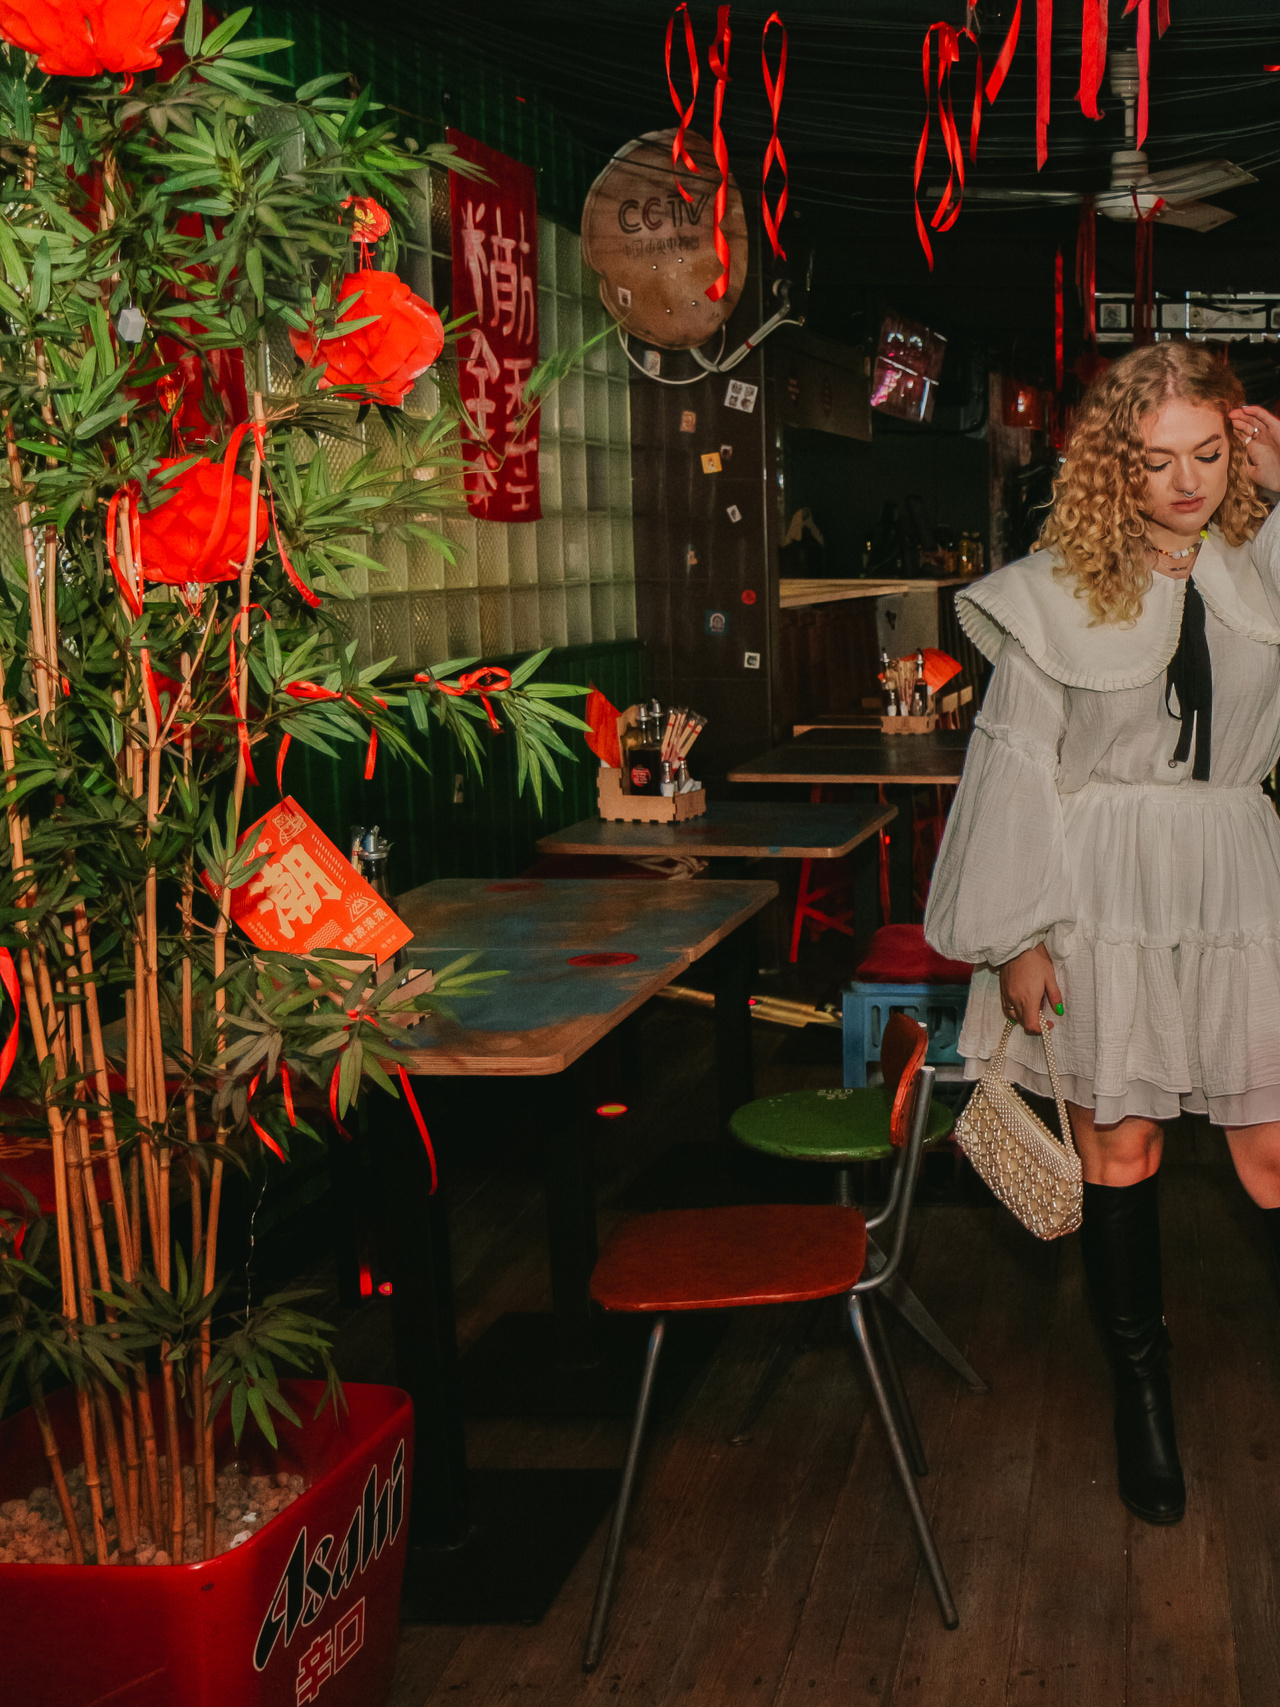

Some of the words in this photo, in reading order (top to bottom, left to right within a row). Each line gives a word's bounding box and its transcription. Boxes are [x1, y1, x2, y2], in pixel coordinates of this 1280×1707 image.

[618, 193, 711, 234] CCTV
[253, 1438, 405, 1672] Asahi
[296, 1596, 366, 1707] 辛口
